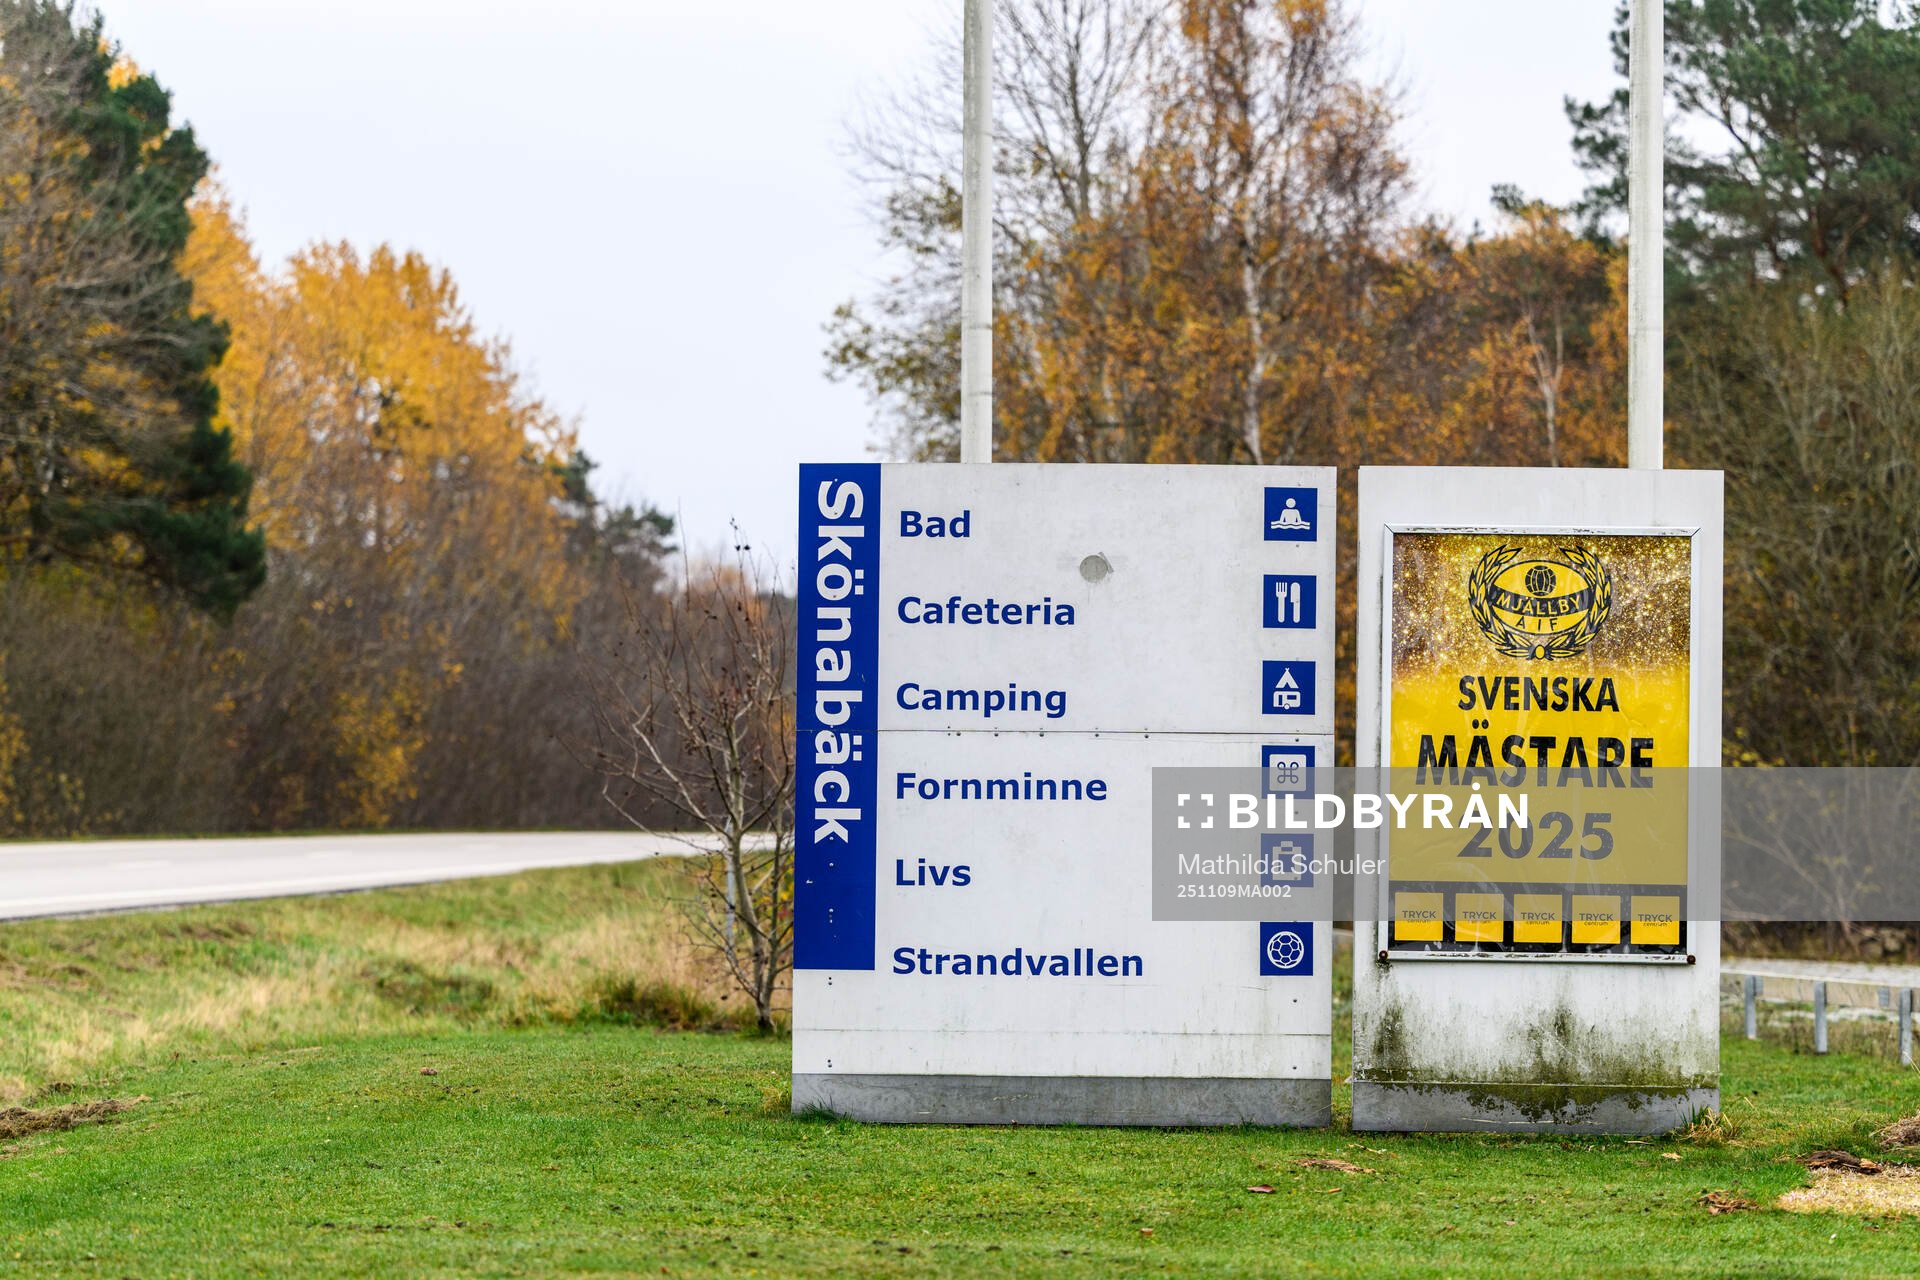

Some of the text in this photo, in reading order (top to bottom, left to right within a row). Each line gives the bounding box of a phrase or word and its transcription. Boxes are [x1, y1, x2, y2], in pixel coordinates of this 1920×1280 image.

[900, 510, 971, 538] Bad
[897, 597, 1076, 626] Cafeteria
[1496, 592, 1580, 615] MJÄLLBY
[813, 480, 865, 845] Skönabäck
[896, 684, 1067, 718] Camping
[1457, 675, 1620, 712] SVENSKA
[1415, 718, 1654, 789] MÄSTARE
[896, 772, 1108, 801] Fornminne
[1456, 812, 1614, 860] 2025
[895, 859, 972, 887] Livs
[1402, 910, 1436, 919] TRYCK
[1462, 911, 1496, 920] TRYCK
[1521, 912, 1555, 921] TRYCK
[1579, 913, 1613, 922] TRYCK
[1637, 914, 1671, 923] TRYCK
[892, 948, 1144, 978] Strandvallen
